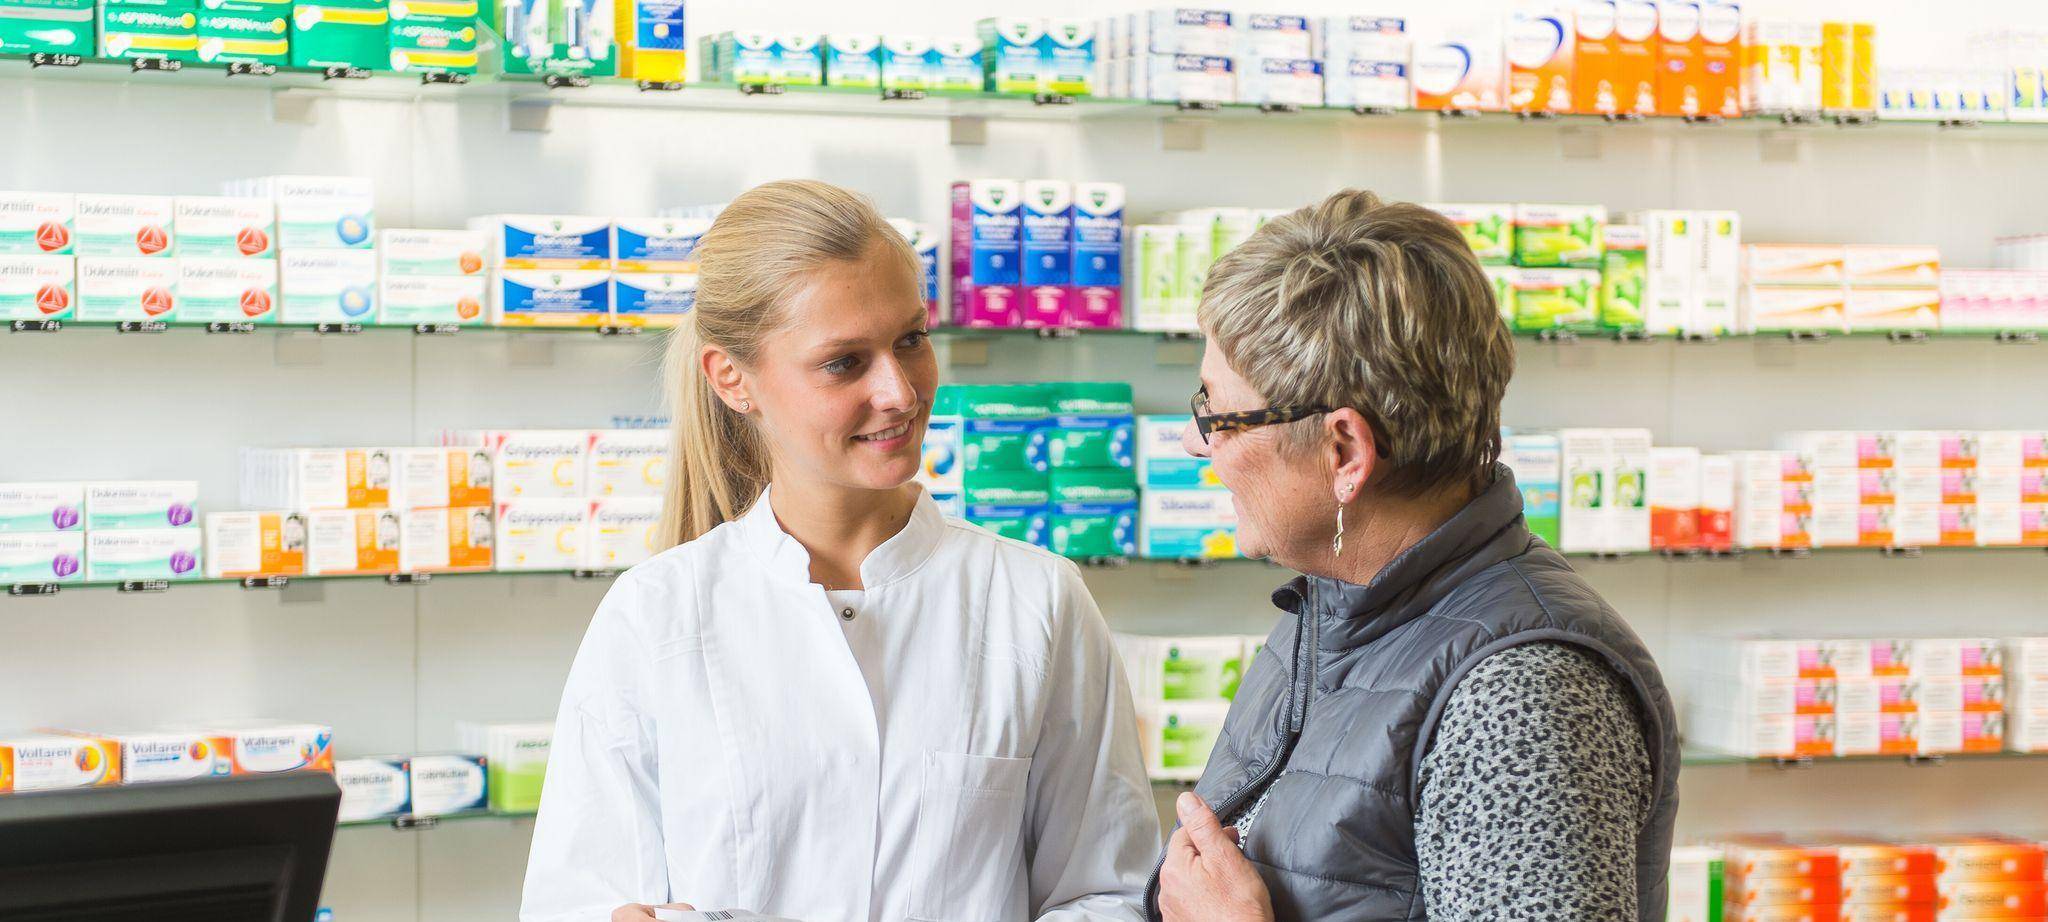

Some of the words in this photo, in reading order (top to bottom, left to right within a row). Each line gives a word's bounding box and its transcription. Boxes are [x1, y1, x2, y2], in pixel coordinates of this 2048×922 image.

[132, 741, 186, 754] Voltaren
[242, 737, 295, 748] Voltaren
[17, 746, 72, 760] Voltaren
